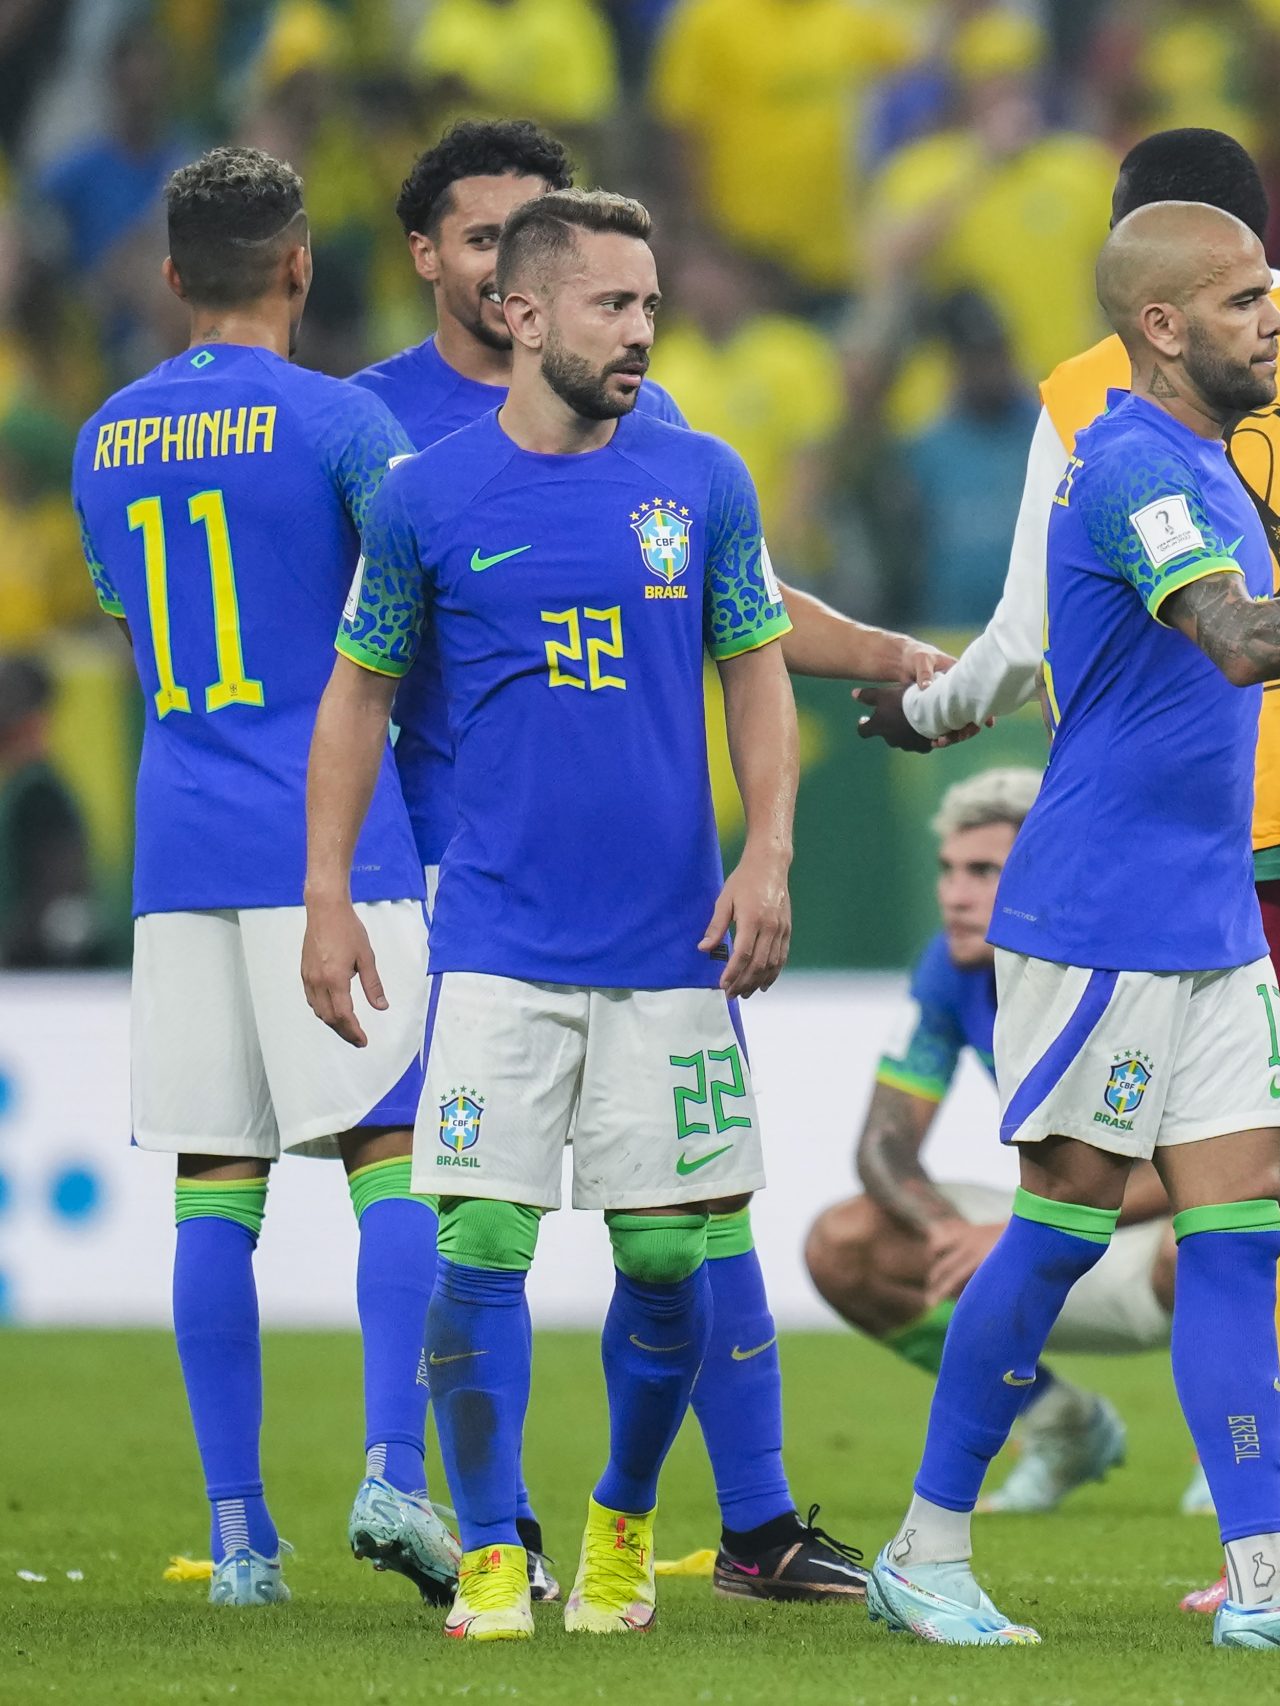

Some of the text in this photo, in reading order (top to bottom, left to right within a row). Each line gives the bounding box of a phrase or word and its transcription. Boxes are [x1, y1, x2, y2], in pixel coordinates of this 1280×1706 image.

[93, 405, 277, 471] RAPHINHA
[654, 536, 676, 547] CBF
[644, 586, 688, 599] BRASIL
[126, 489, 265, 721] 11
[540, 605, 627, 691] 22
[669, 1043, 752, 1140] 22
[1118, 1079, 1136, 1091] CBF
[451, 1117, 469, 1129] CBF
[1093, 1111, 1134, 1131] BRASIL
[436, 1155, 481, 1169] BRASIL
[1227, 1414, 1260, 1465] BRASIL
